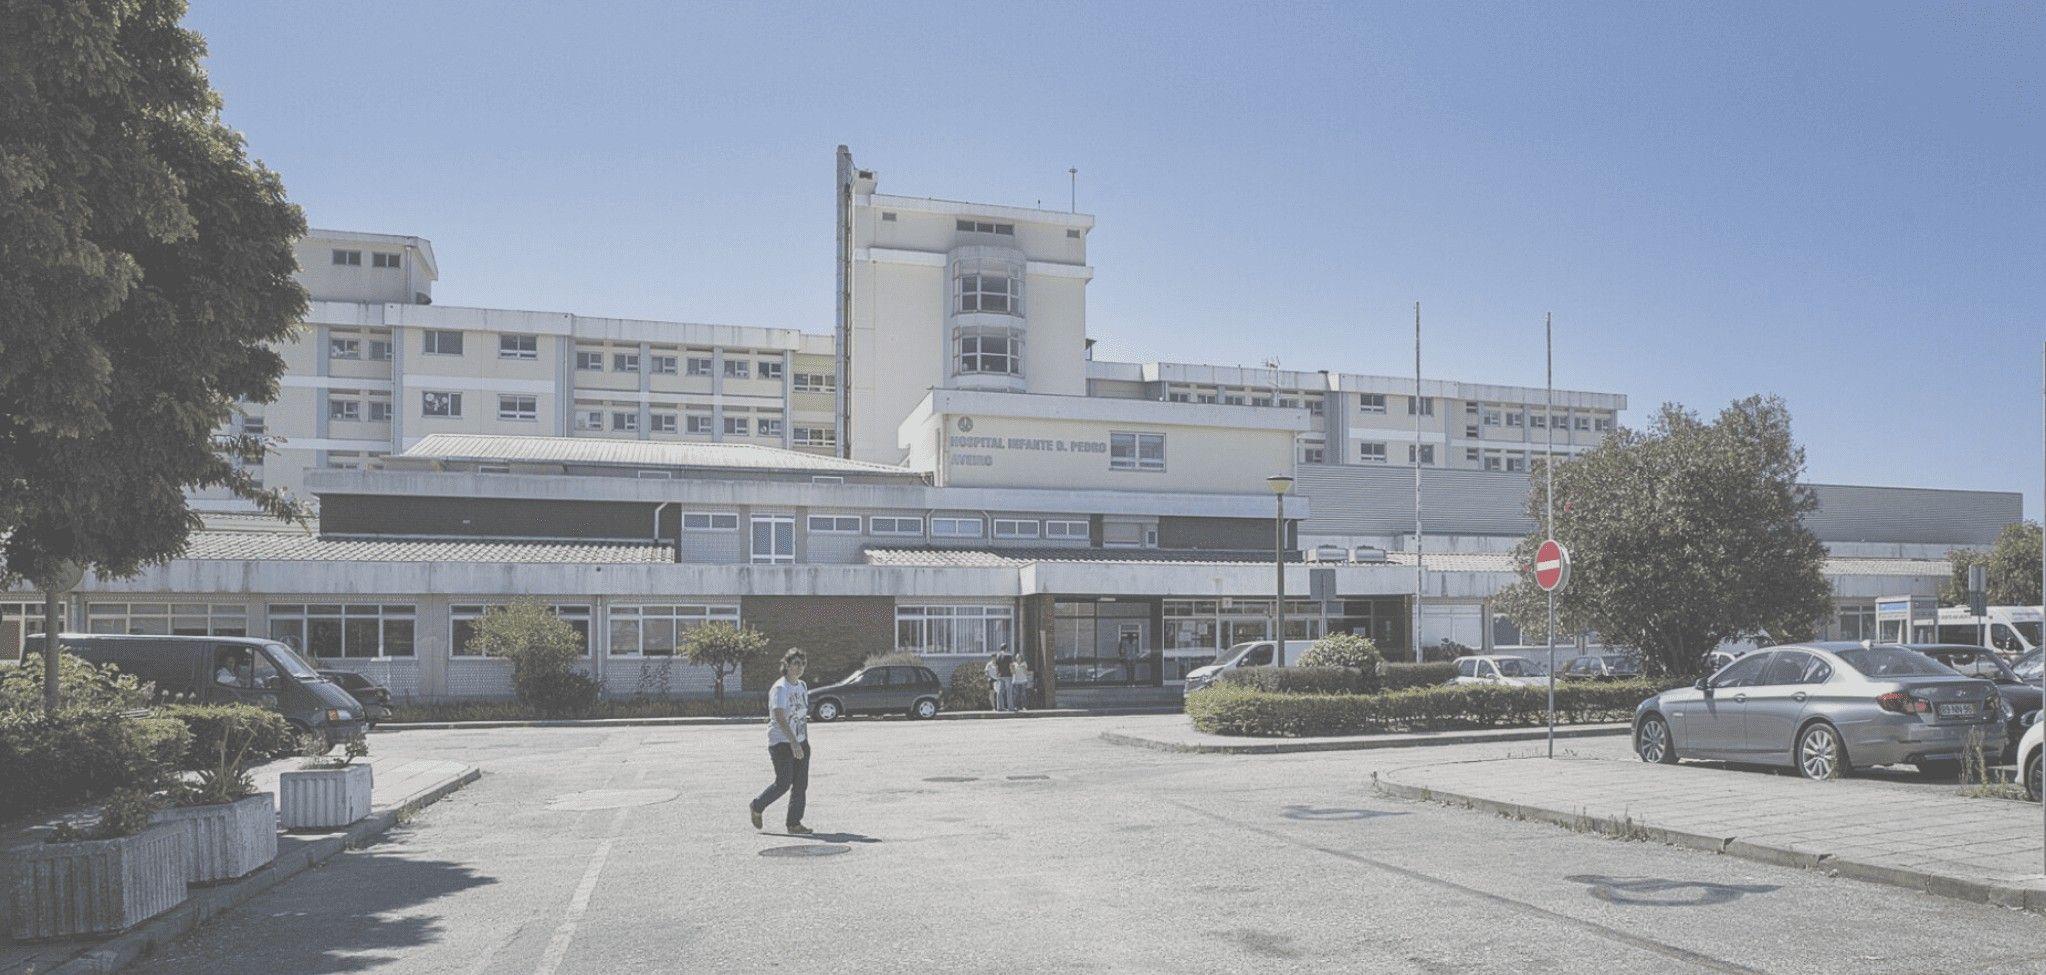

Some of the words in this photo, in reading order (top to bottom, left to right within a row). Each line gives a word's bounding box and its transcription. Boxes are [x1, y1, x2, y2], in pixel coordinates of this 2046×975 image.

[950, 436, 1005, 449] HOSPITAL
[1007, 438, 1053, 451] INFANTE
[1056, 440, 1068, 451] D.
[1070, 441, 1107, 453] PEDRO
[950, 454, 993, 466] AVEIRO
